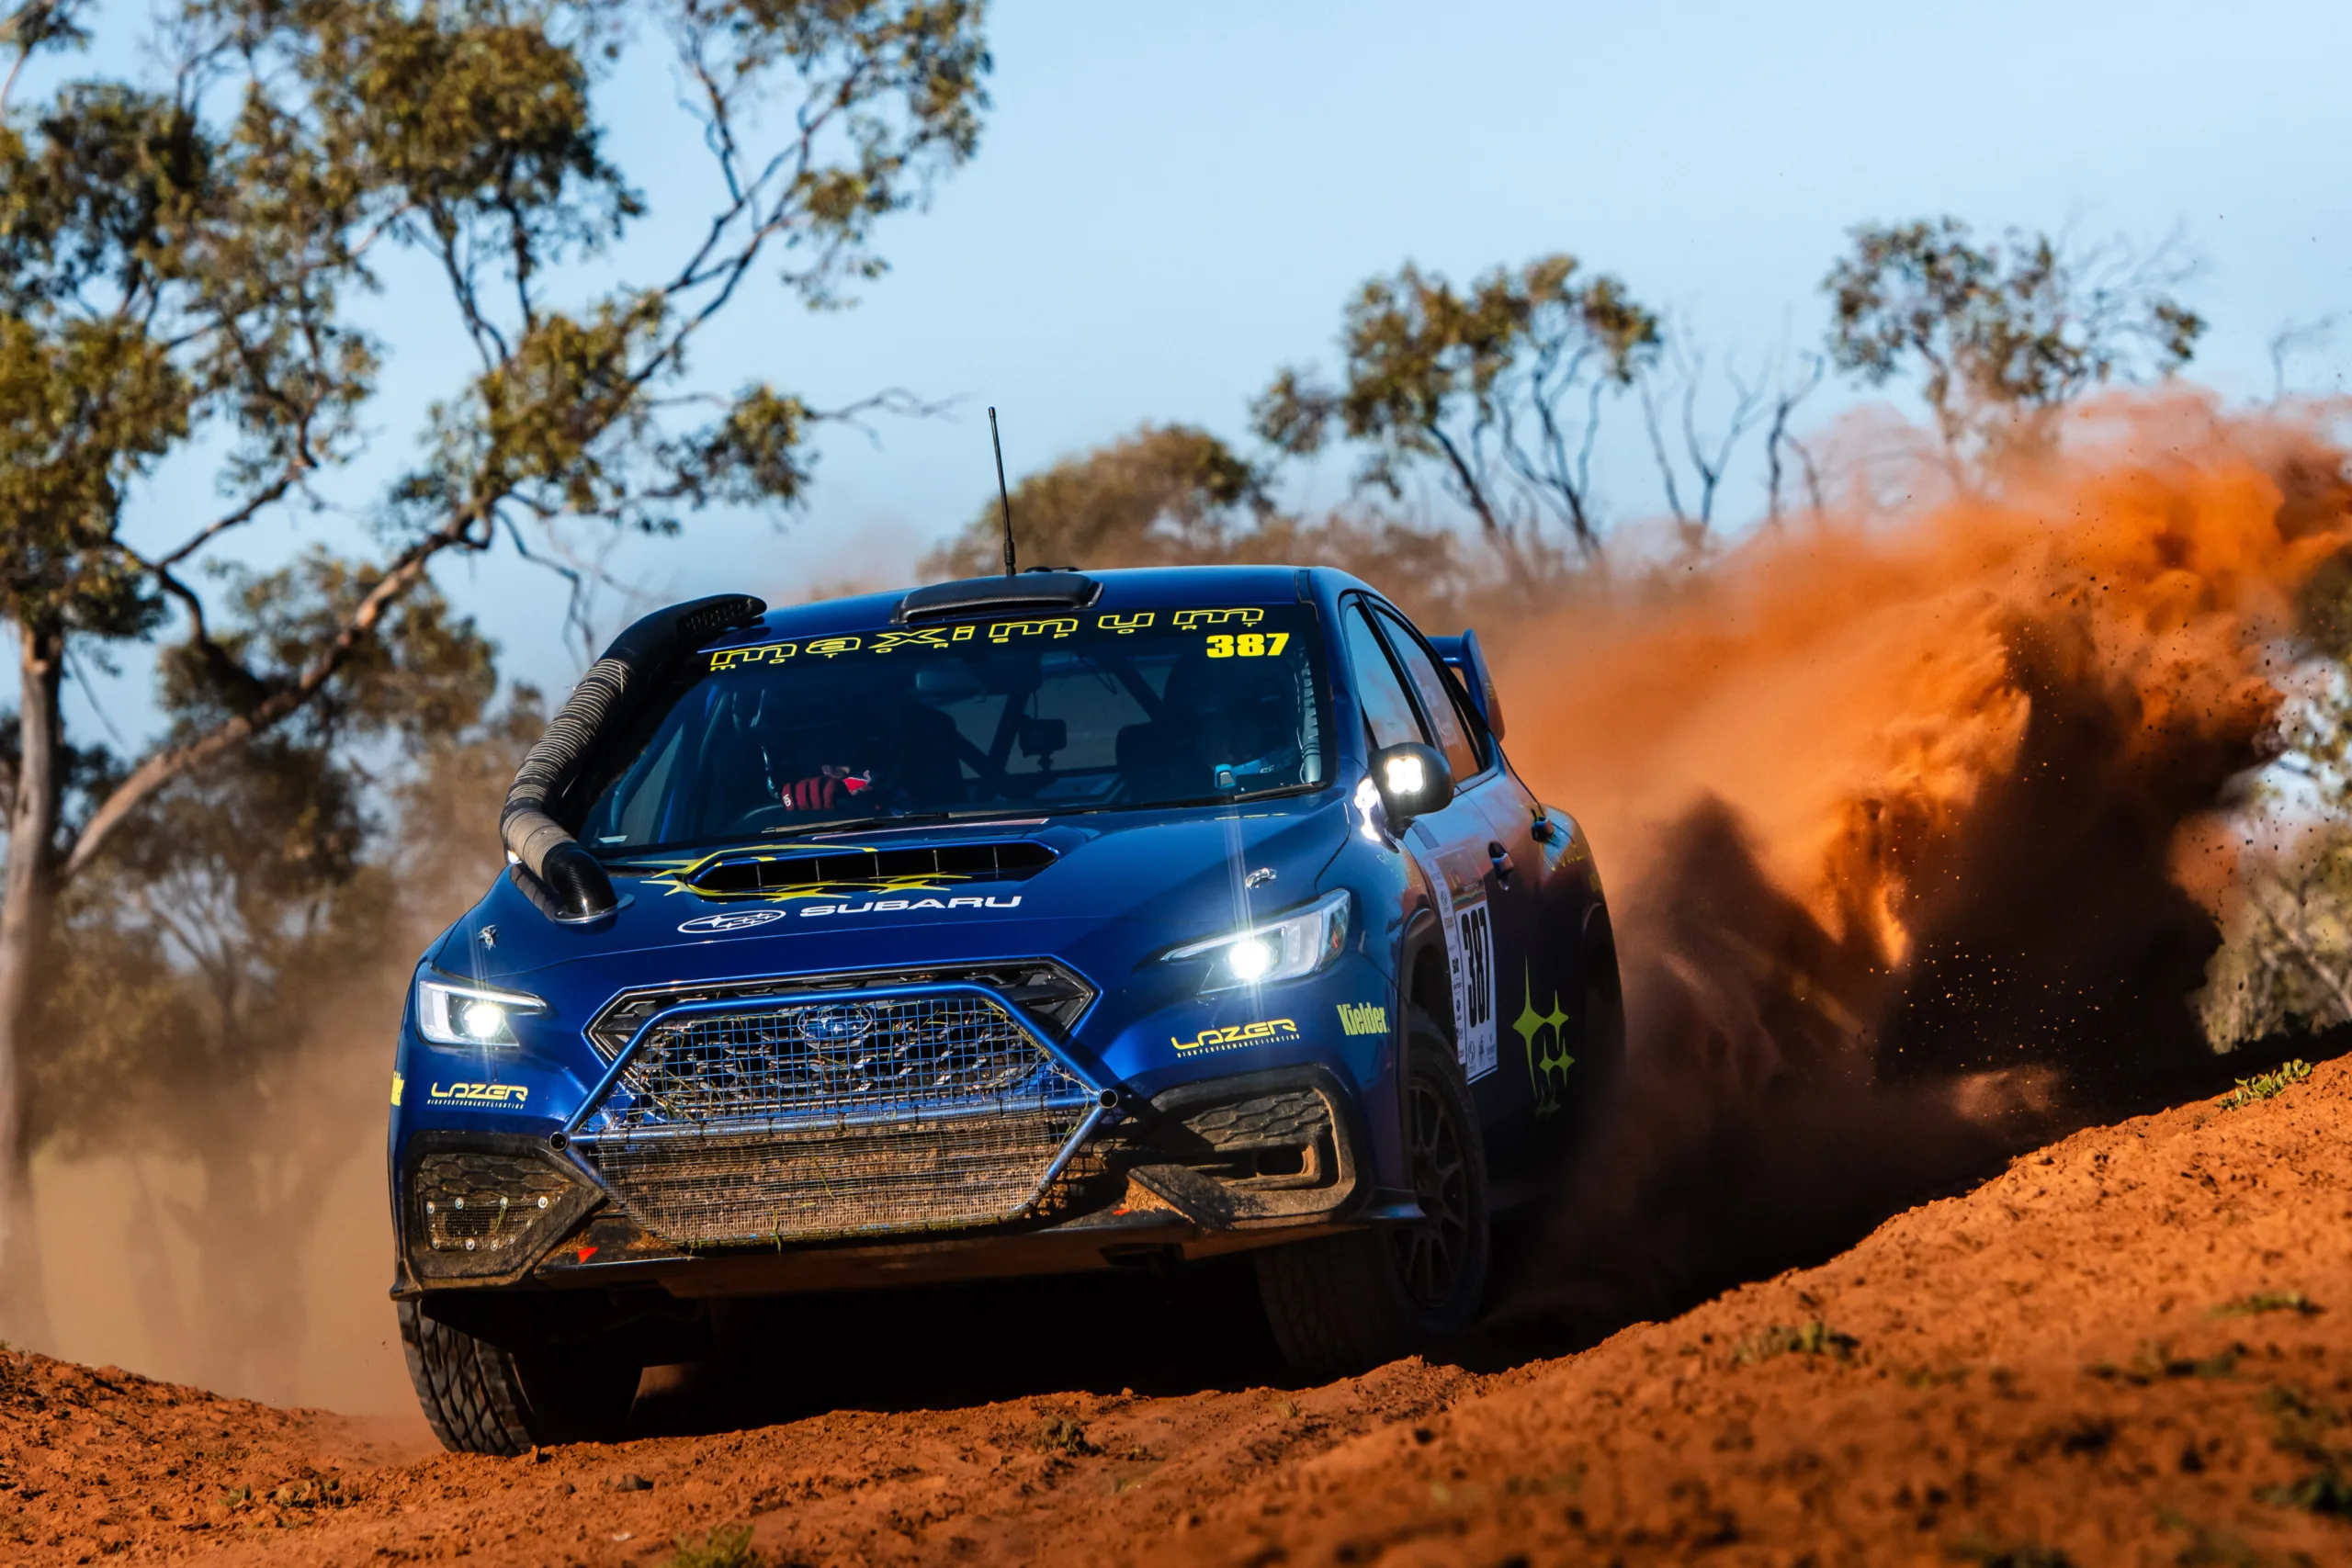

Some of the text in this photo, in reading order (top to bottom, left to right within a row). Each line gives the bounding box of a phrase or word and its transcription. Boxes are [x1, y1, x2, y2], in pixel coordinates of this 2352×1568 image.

[1206, 633, 1289, 658] 387
[799, 896, 1023, 917] SUBARU
[1461, 907, 1490, 1028] 387
[1170, 1019, 1297, 1050] LAZER
[1199, 1039, 1260, 1055] PERFORMANCE
[1261, 1033, 1300, 1045] LIGHTING
[431, 1082, 528, 1101] LAZER
